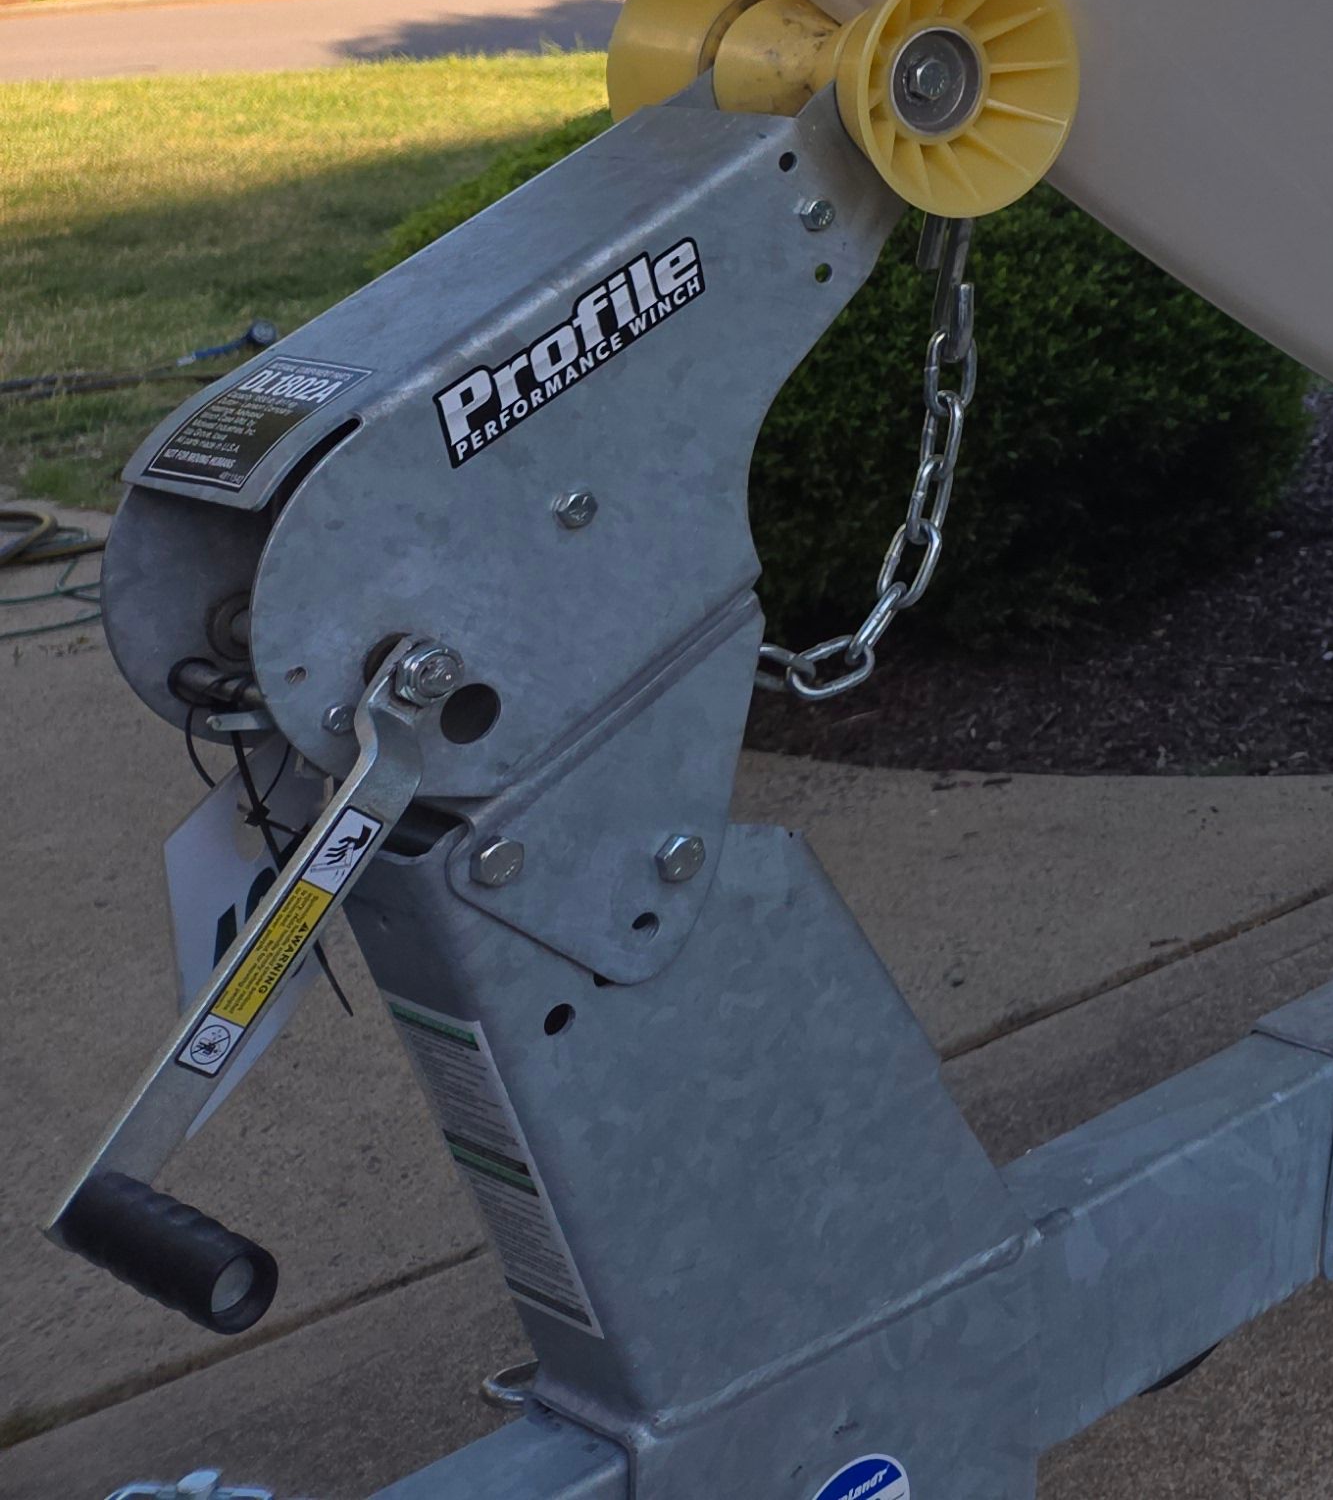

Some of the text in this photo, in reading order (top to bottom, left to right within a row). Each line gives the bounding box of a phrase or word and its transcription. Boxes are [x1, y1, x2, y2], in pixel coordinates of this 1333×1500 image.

[237, 369, 343, 404] DL1802A
[438, 241, 699, 446] Profile
[455, 276, 701, 461] PERFORMANCE WINCH
[257, 933, 303, 995] WARNING
